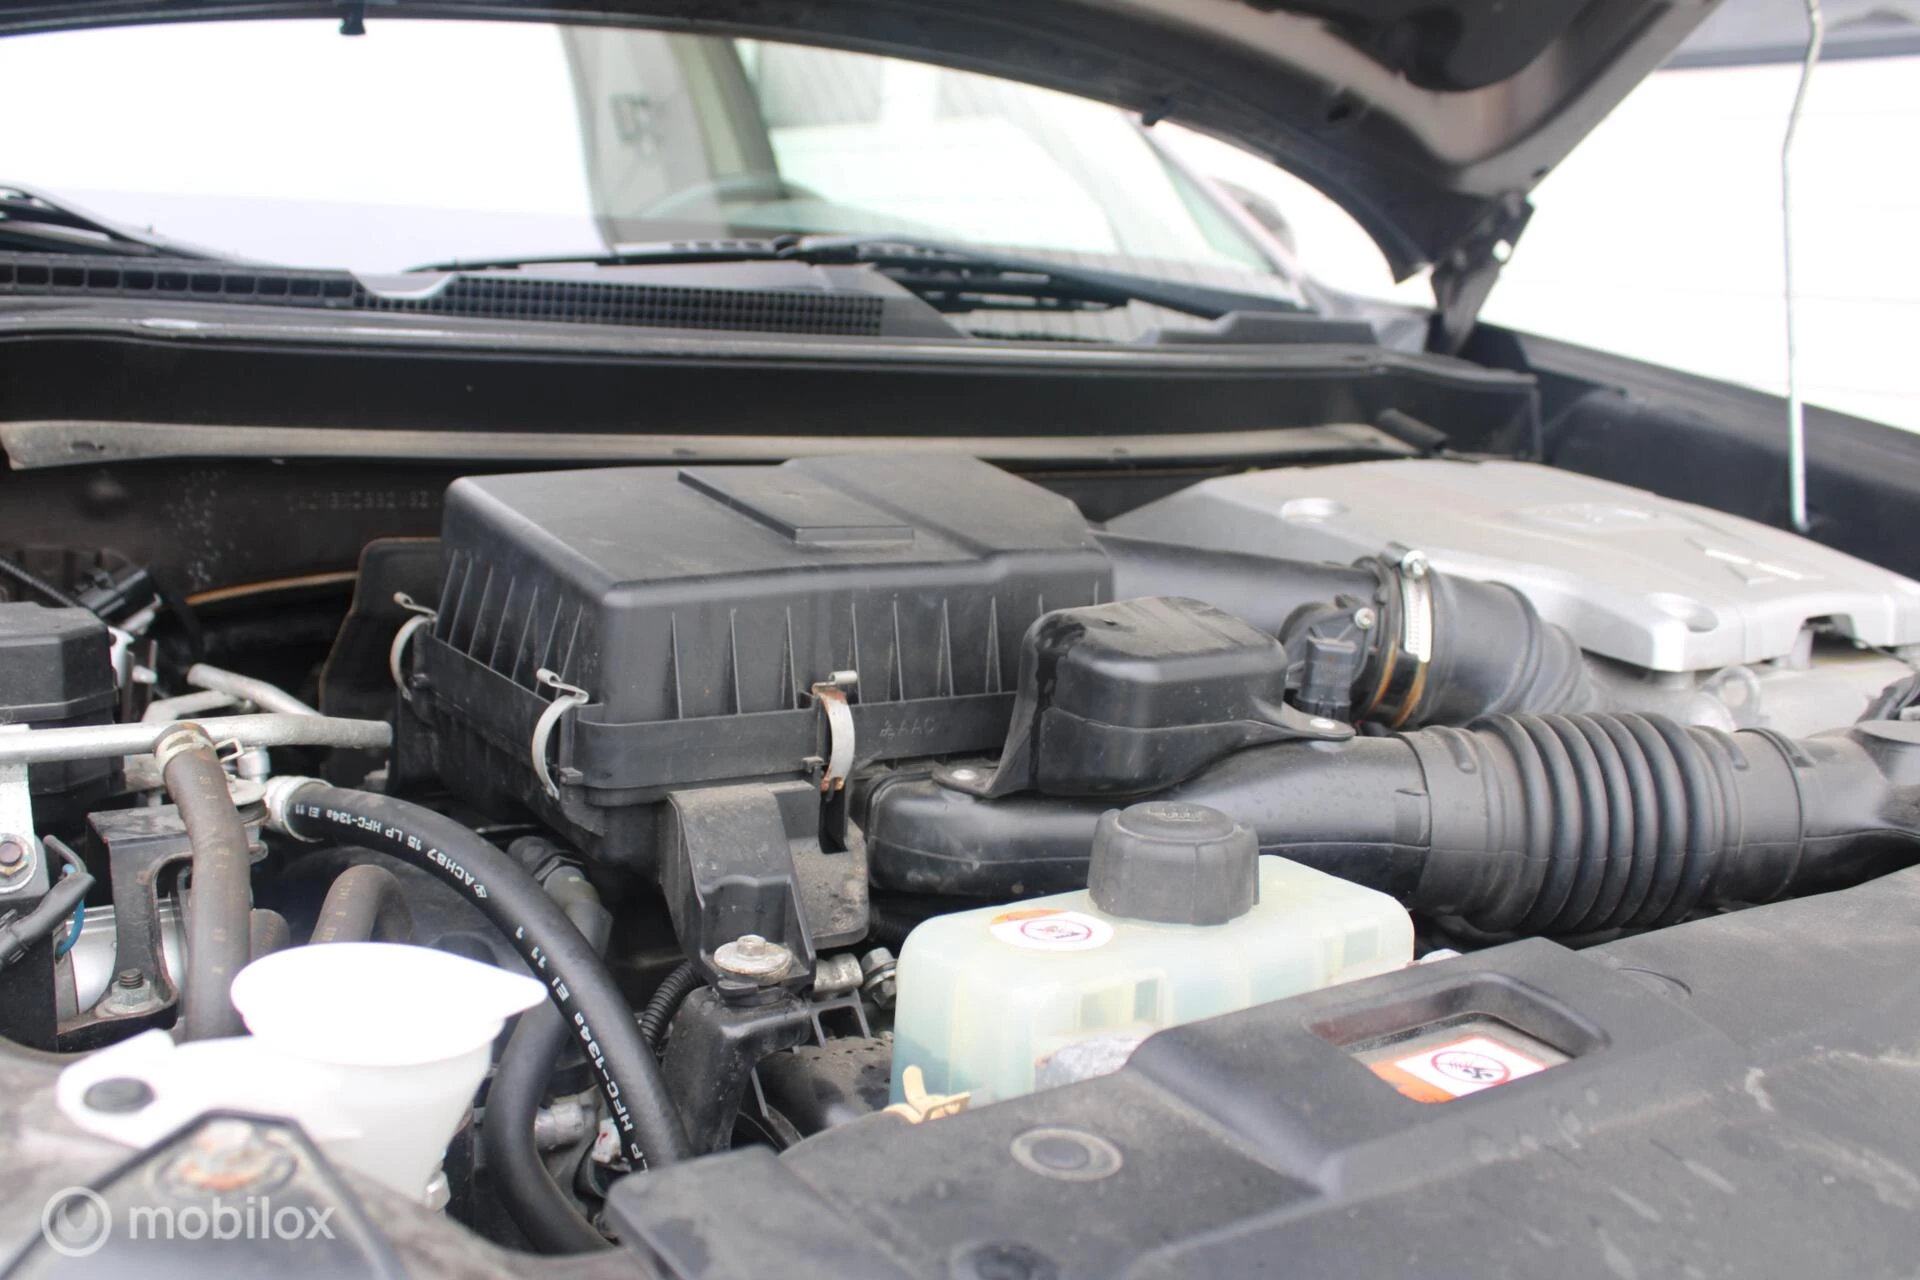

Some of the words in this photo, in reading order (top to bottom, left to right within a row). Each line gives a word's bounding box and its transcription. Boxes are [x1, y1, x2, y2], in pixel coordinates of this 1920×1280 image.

[326, 809, 382, 834] HFC-134a
[384, 827, 404, 843] LP
[531, 946, 546, 969] 11
[574, 1011, 634, 1132] HFC-134a
